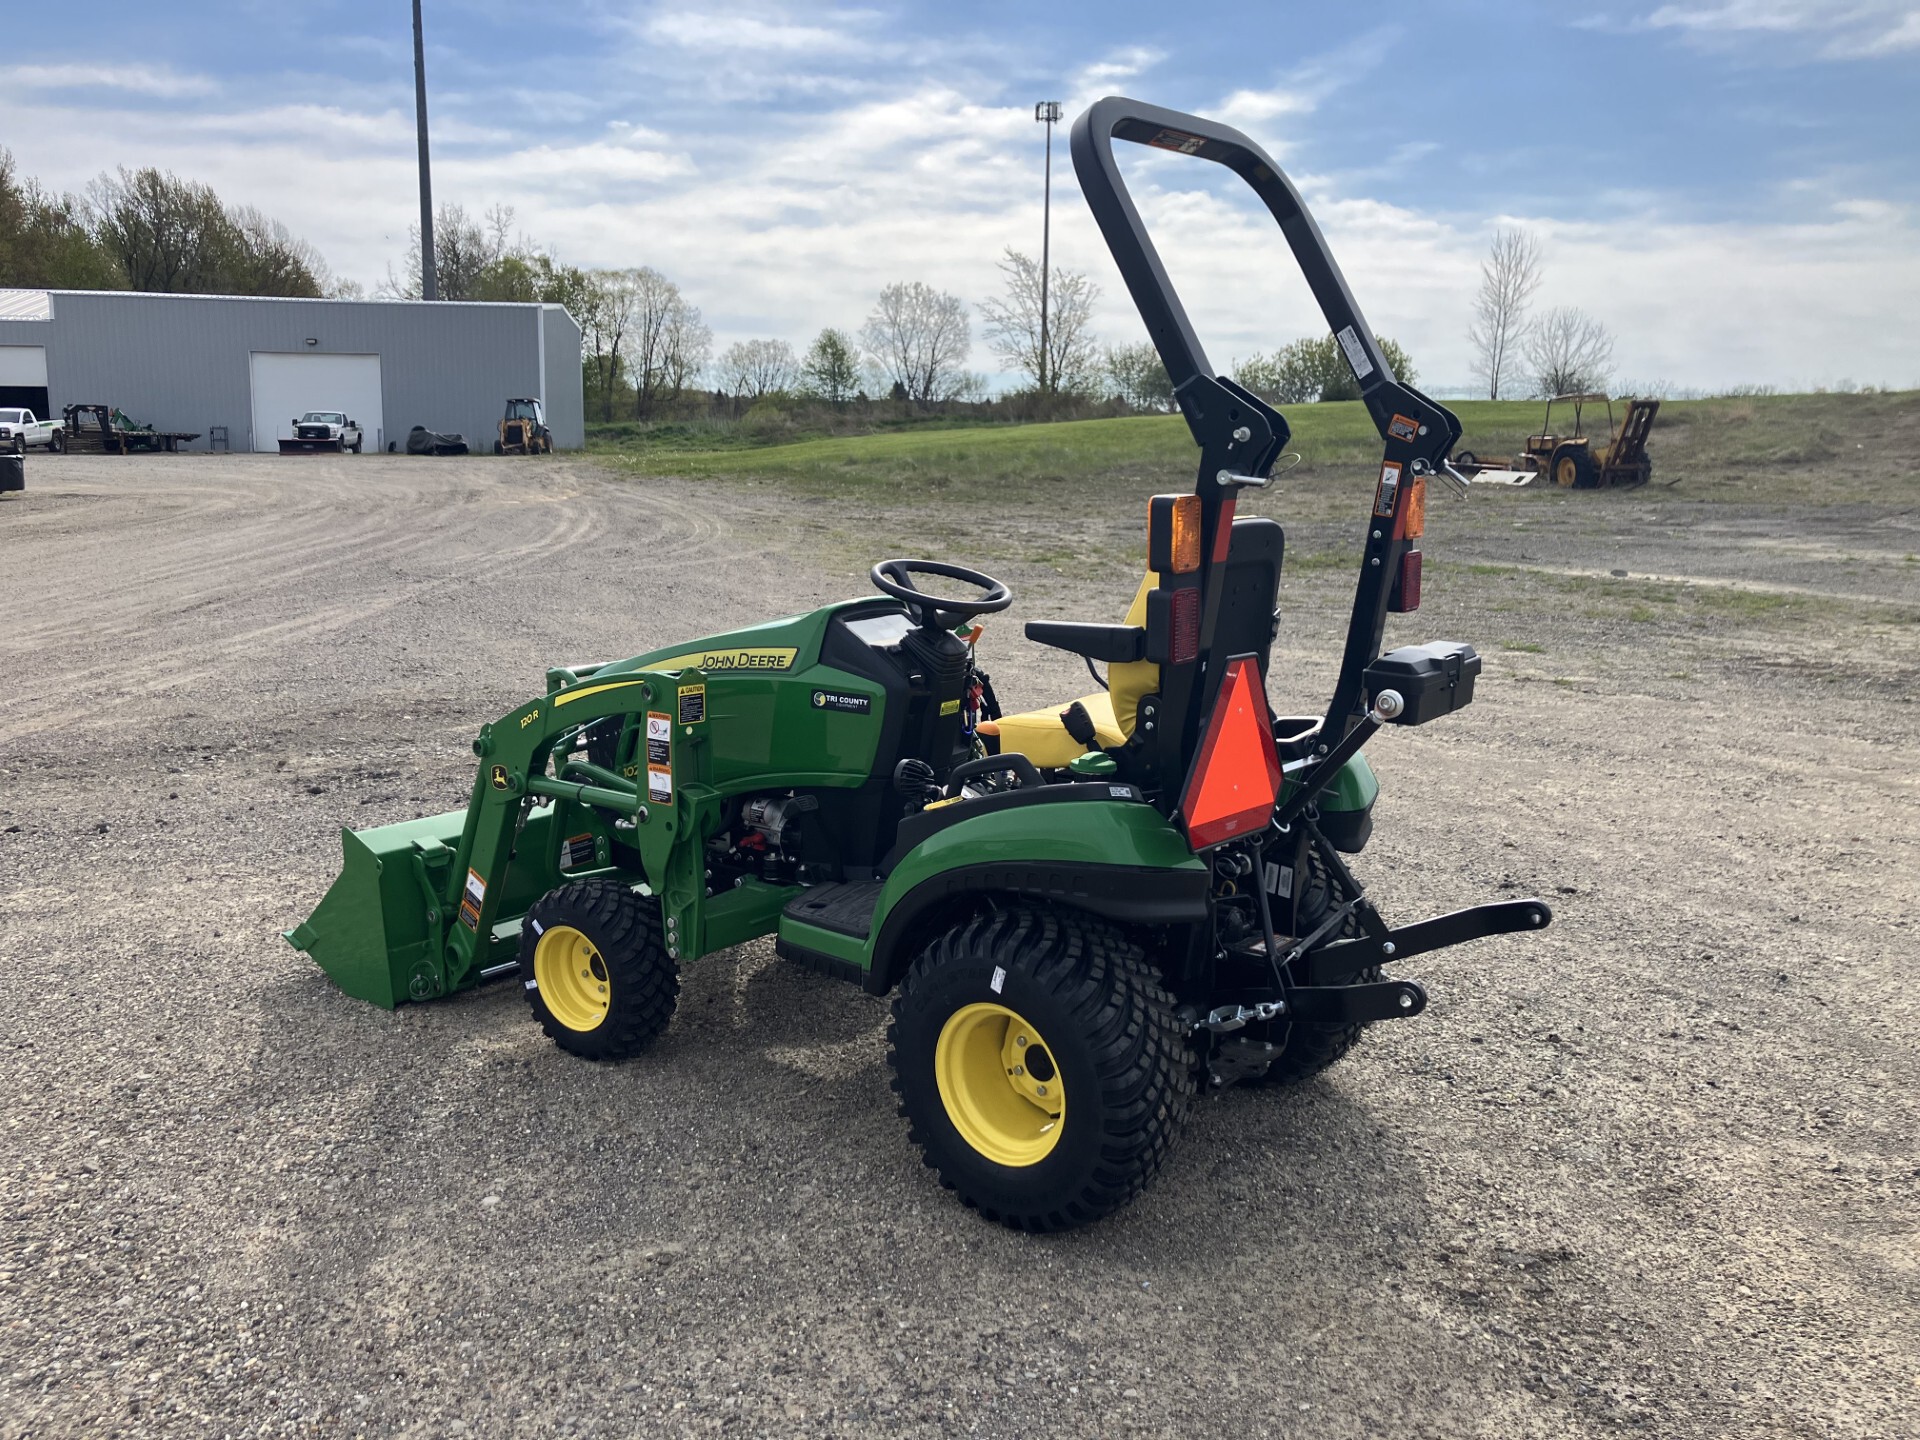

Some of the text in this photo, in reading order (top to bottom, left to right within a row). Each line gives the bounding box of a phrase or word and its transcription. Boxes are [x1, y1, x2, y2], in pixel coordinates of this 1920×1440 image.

[698, 653, 786, 668] JOHN DEERE
[686, 686, 704, 694] CAUTION
[826, 695, 868, 706] TRI COUNTY
